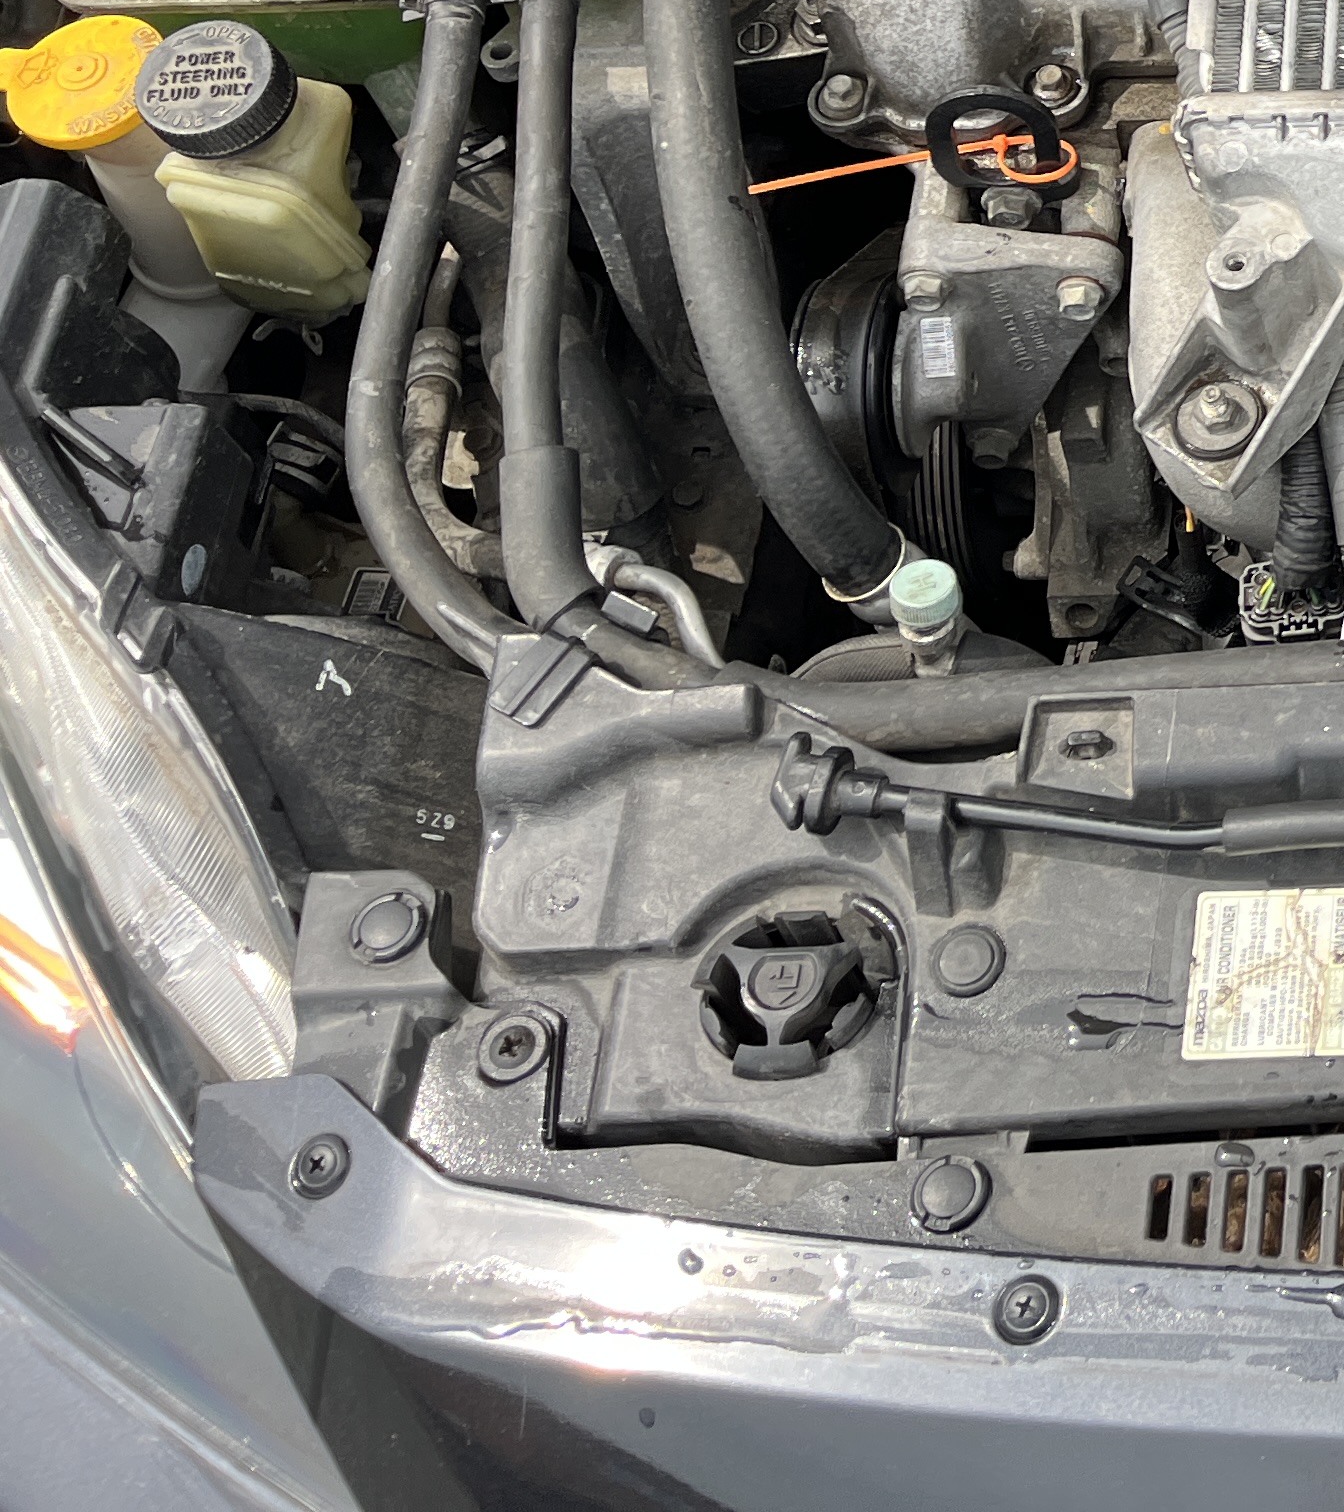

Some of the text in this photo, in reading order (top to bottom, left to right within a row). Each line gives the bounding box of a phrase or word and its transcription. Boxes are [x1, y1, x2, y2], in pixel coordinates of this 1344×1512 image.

[205, 25, 252, 45] OPEN
[174, 50, 237, 68] POWER
[158, 66, 248, 87] STEERING
[146, 82, 254, 104] FLUID ONLY
[153, 104, 206, 129] CLOSE
[1217, 906, 1235, 974] CONDITIONER
[1193, 989, 1208, 1046] mazda
[1206, 904, 1216, 931] JAPAN
